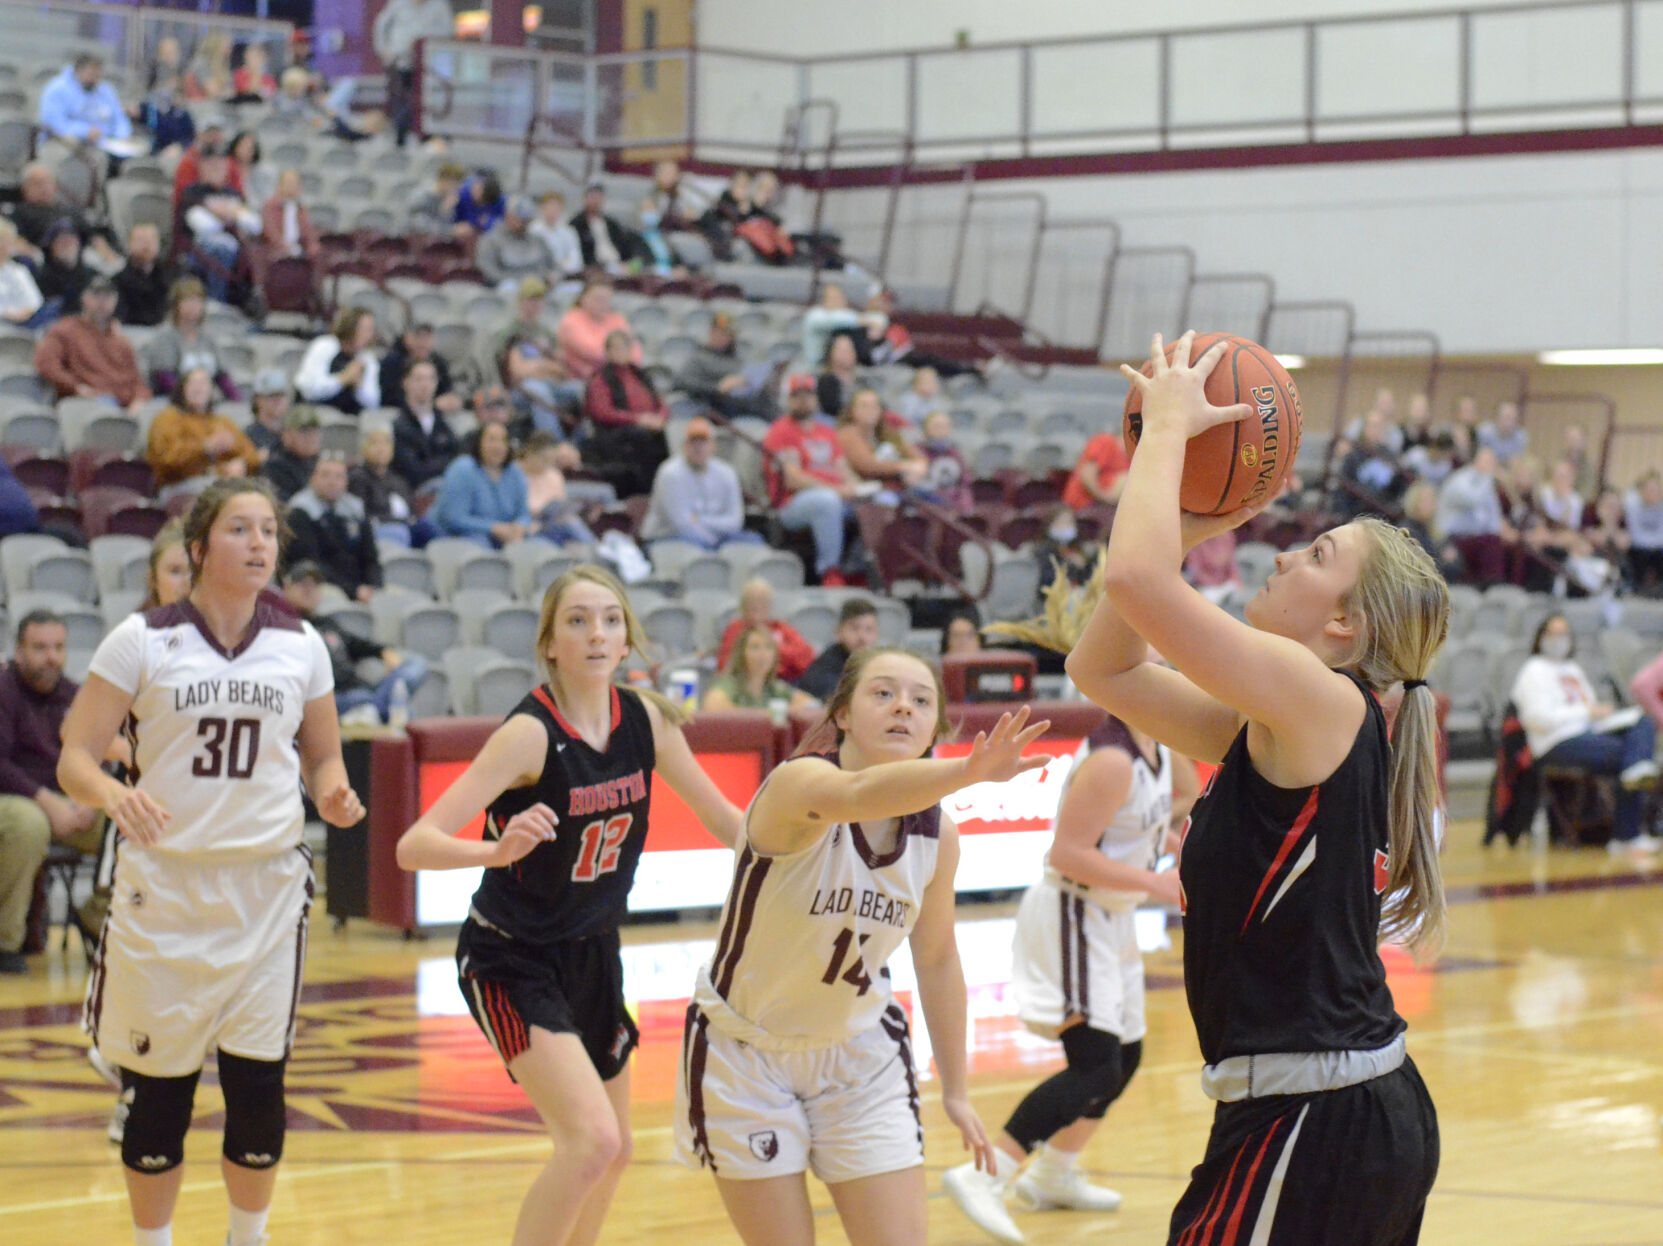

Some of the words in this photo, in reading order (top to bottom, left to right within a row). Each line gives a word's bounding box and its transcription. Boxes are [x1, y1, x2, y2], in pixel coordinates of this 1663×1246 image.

[1240, 385, 1279, 504] SPALDING
[175, 680, 220, 711] LADY
[228, 680, 284, 715] BEARS
[192, 717, 262, 779] 30
[570, 812, 634, 882] 12
[809, 887, 857, 915] LAD
[821, 927, 873, 997] 14
